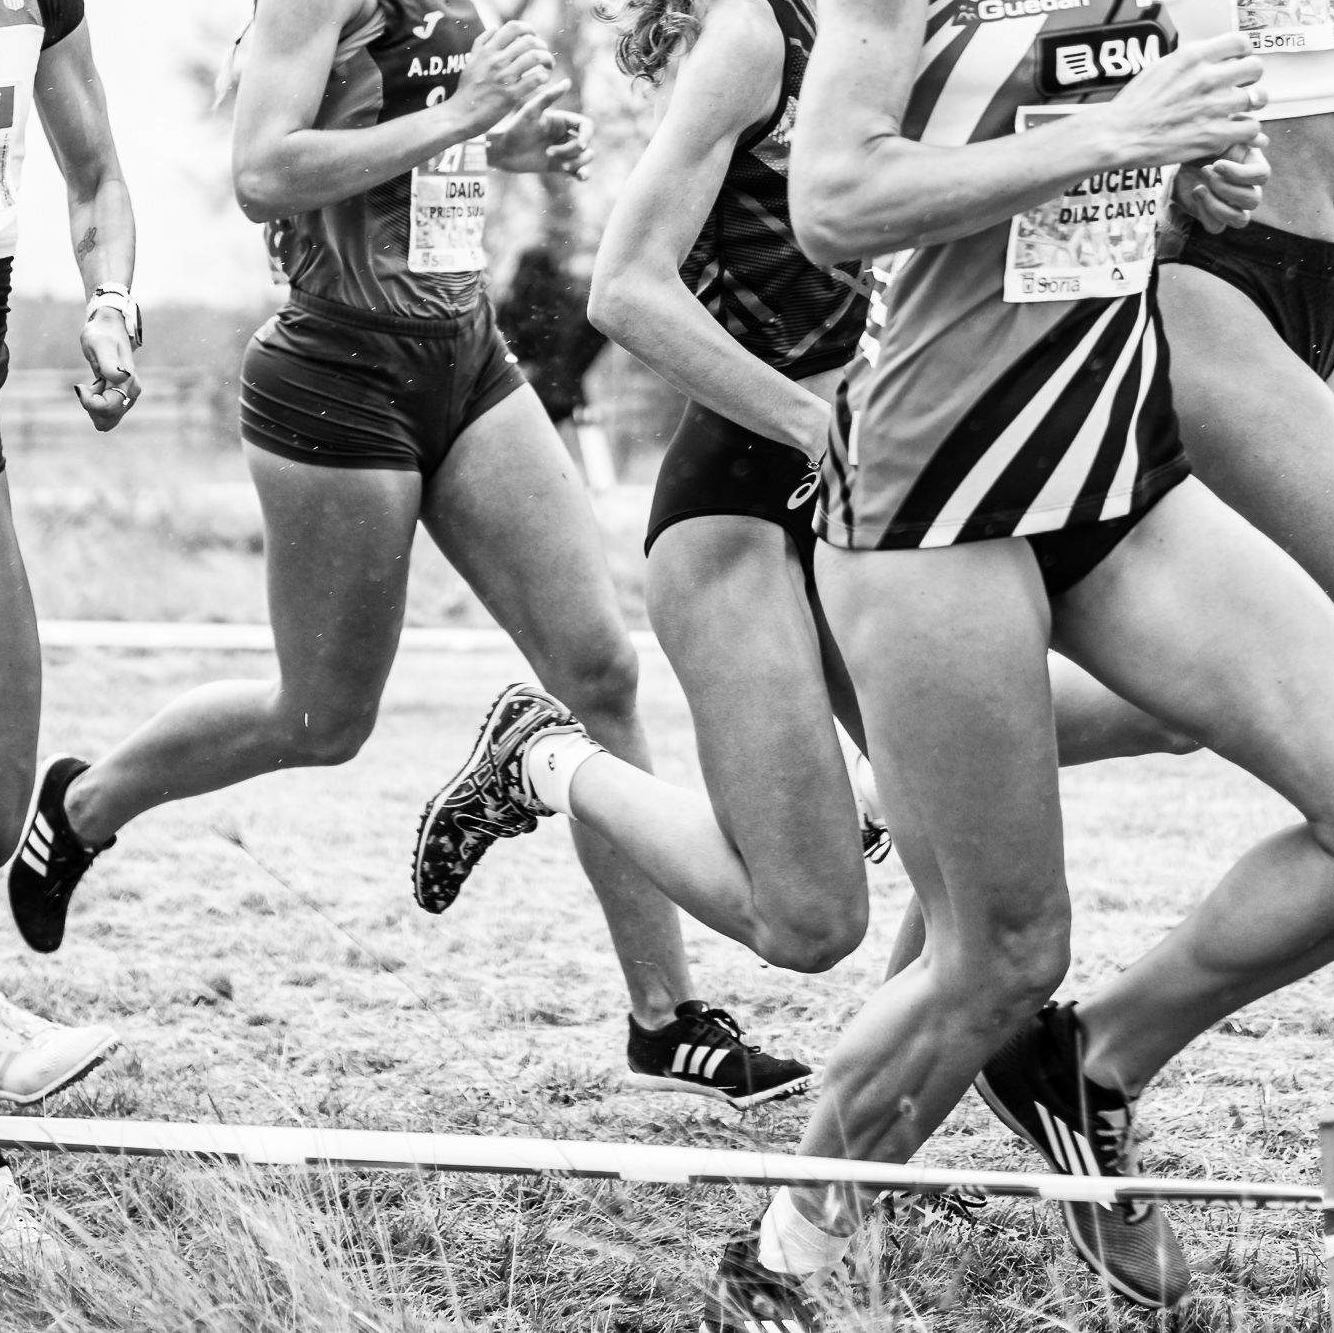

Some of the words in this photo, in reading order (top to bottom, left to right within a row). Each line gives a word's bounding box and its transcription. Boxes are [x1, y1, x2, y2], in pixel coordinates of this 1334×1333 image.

[1264, 34, 1306, 48] Soria
[1100, 34, 1162, 77] BM
[429, 206, 464, 219] PRIETO
[1059, 205, 1100, 225] DIAZ
[1104, 199, 1156, 220] CALVO
[1037, 277, 1081, 294] Soria
